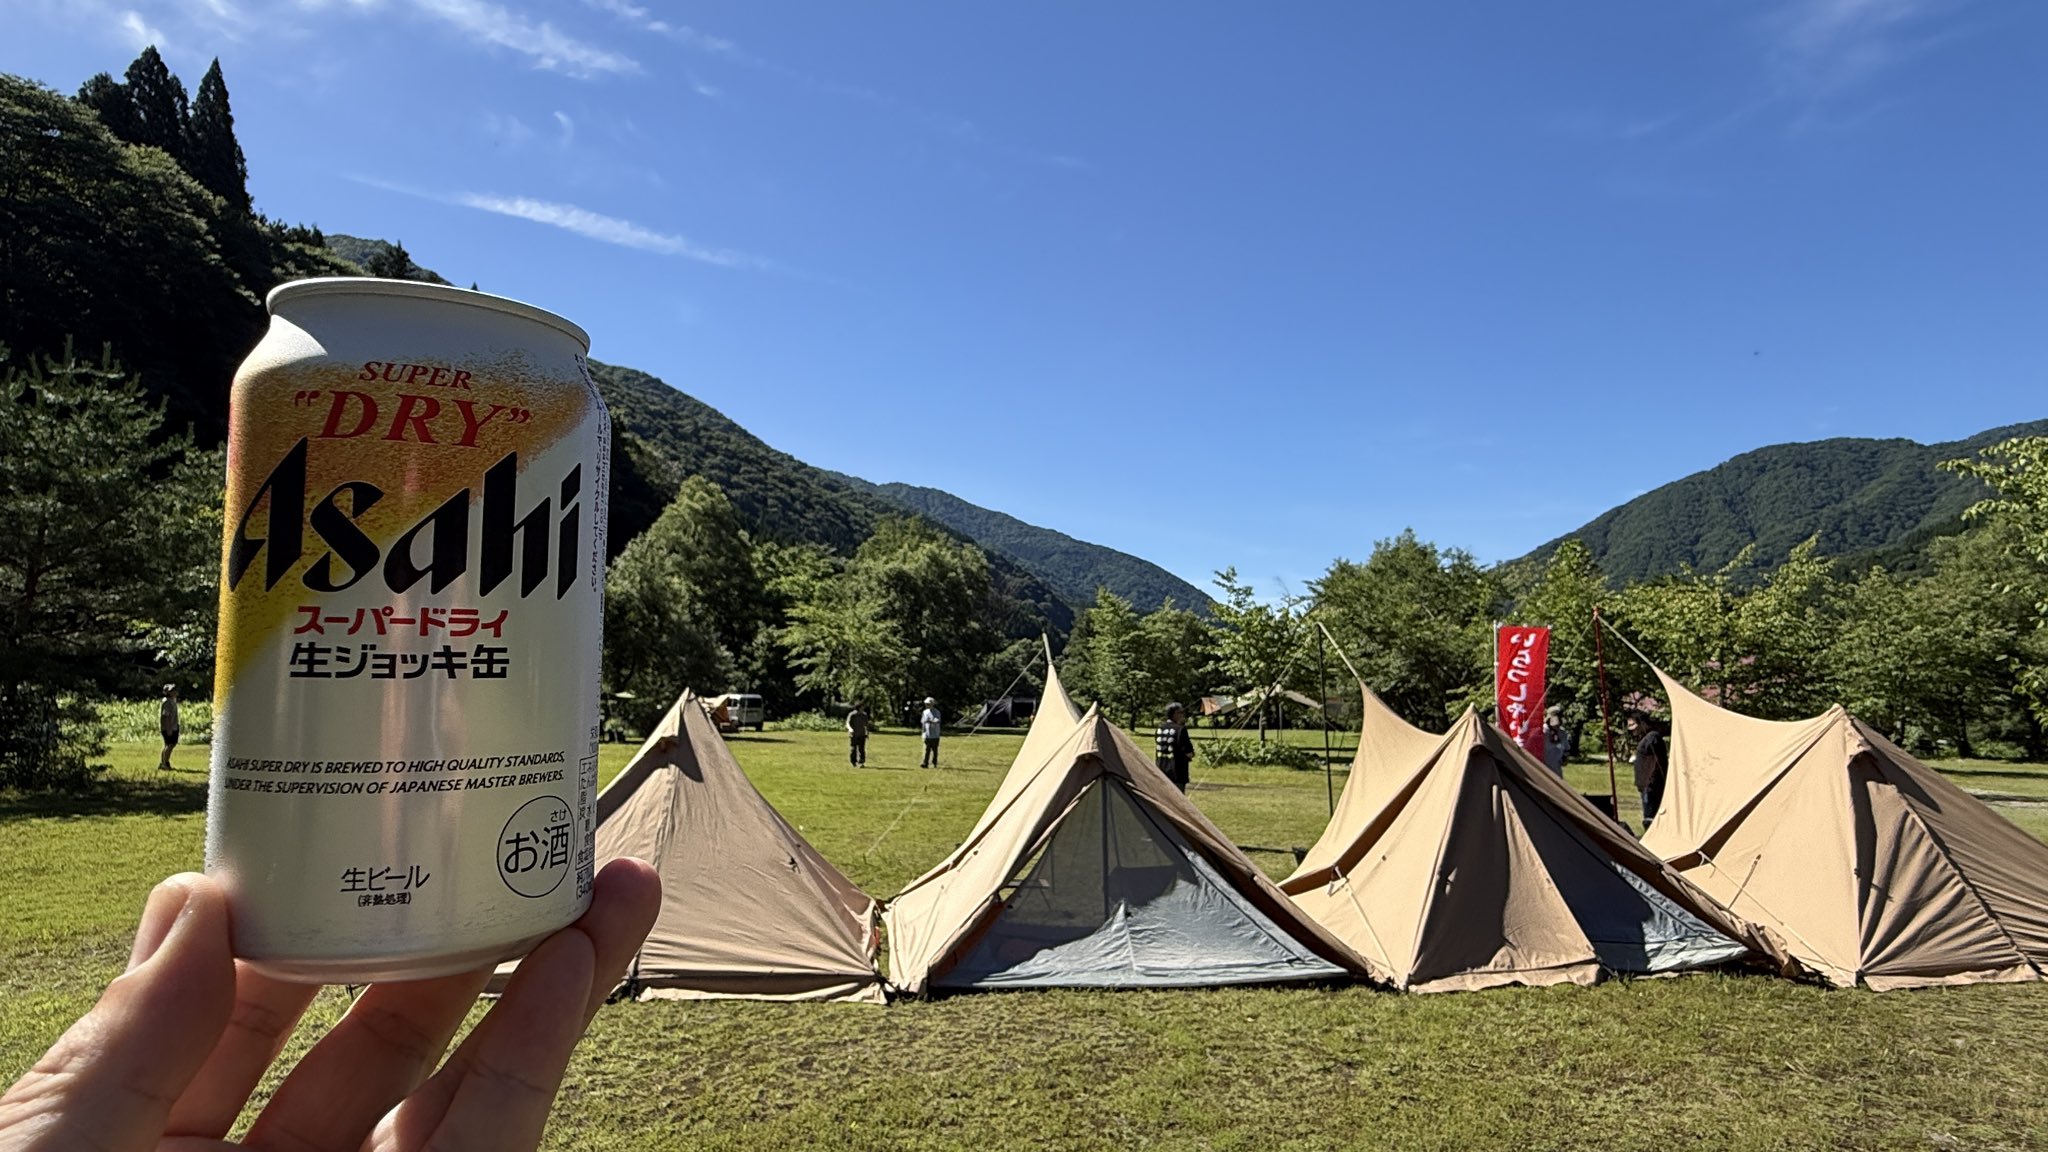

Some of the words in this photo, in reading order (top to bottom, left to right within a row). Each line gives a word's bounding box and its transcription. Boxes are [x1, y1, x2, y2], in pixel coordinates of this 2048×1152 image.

[359, 361, 472, 391] SUPER
[228, 436, 582, 600] Asahi
[293, 605, 510, 638] スーパードライ
[289, 642, 510, 680] 生ジョッキ缶
[250, 759, 283, 772] SUPER
[283, 760, 308, 773] DRY
[311, 761, 324, 774] IS
[324, 761, 383, 774] BREWED
[385, 761, 406, 773] TO
[407, 760, 446, 773] HIGH
[447, 756, 505, 771] QUALITY
[504, 751, 565, 768] STANDARDS,
[225, 777, 251, 791] UNDER
[251, 779, 274, 793] THE
[274, 781, 364, 794] SUPERVISION
[366, 781, 389, 794] OF
[389, 778, 464, 794] JAPANESE
[464, 775, 517, 790] MASTER
[518, 769, 564, 785] BREWERS.
[550, 809, 567, 823] さけ
[504, 822, 570, 874] お酒
[340, 865, 431, 892] 生ビール
